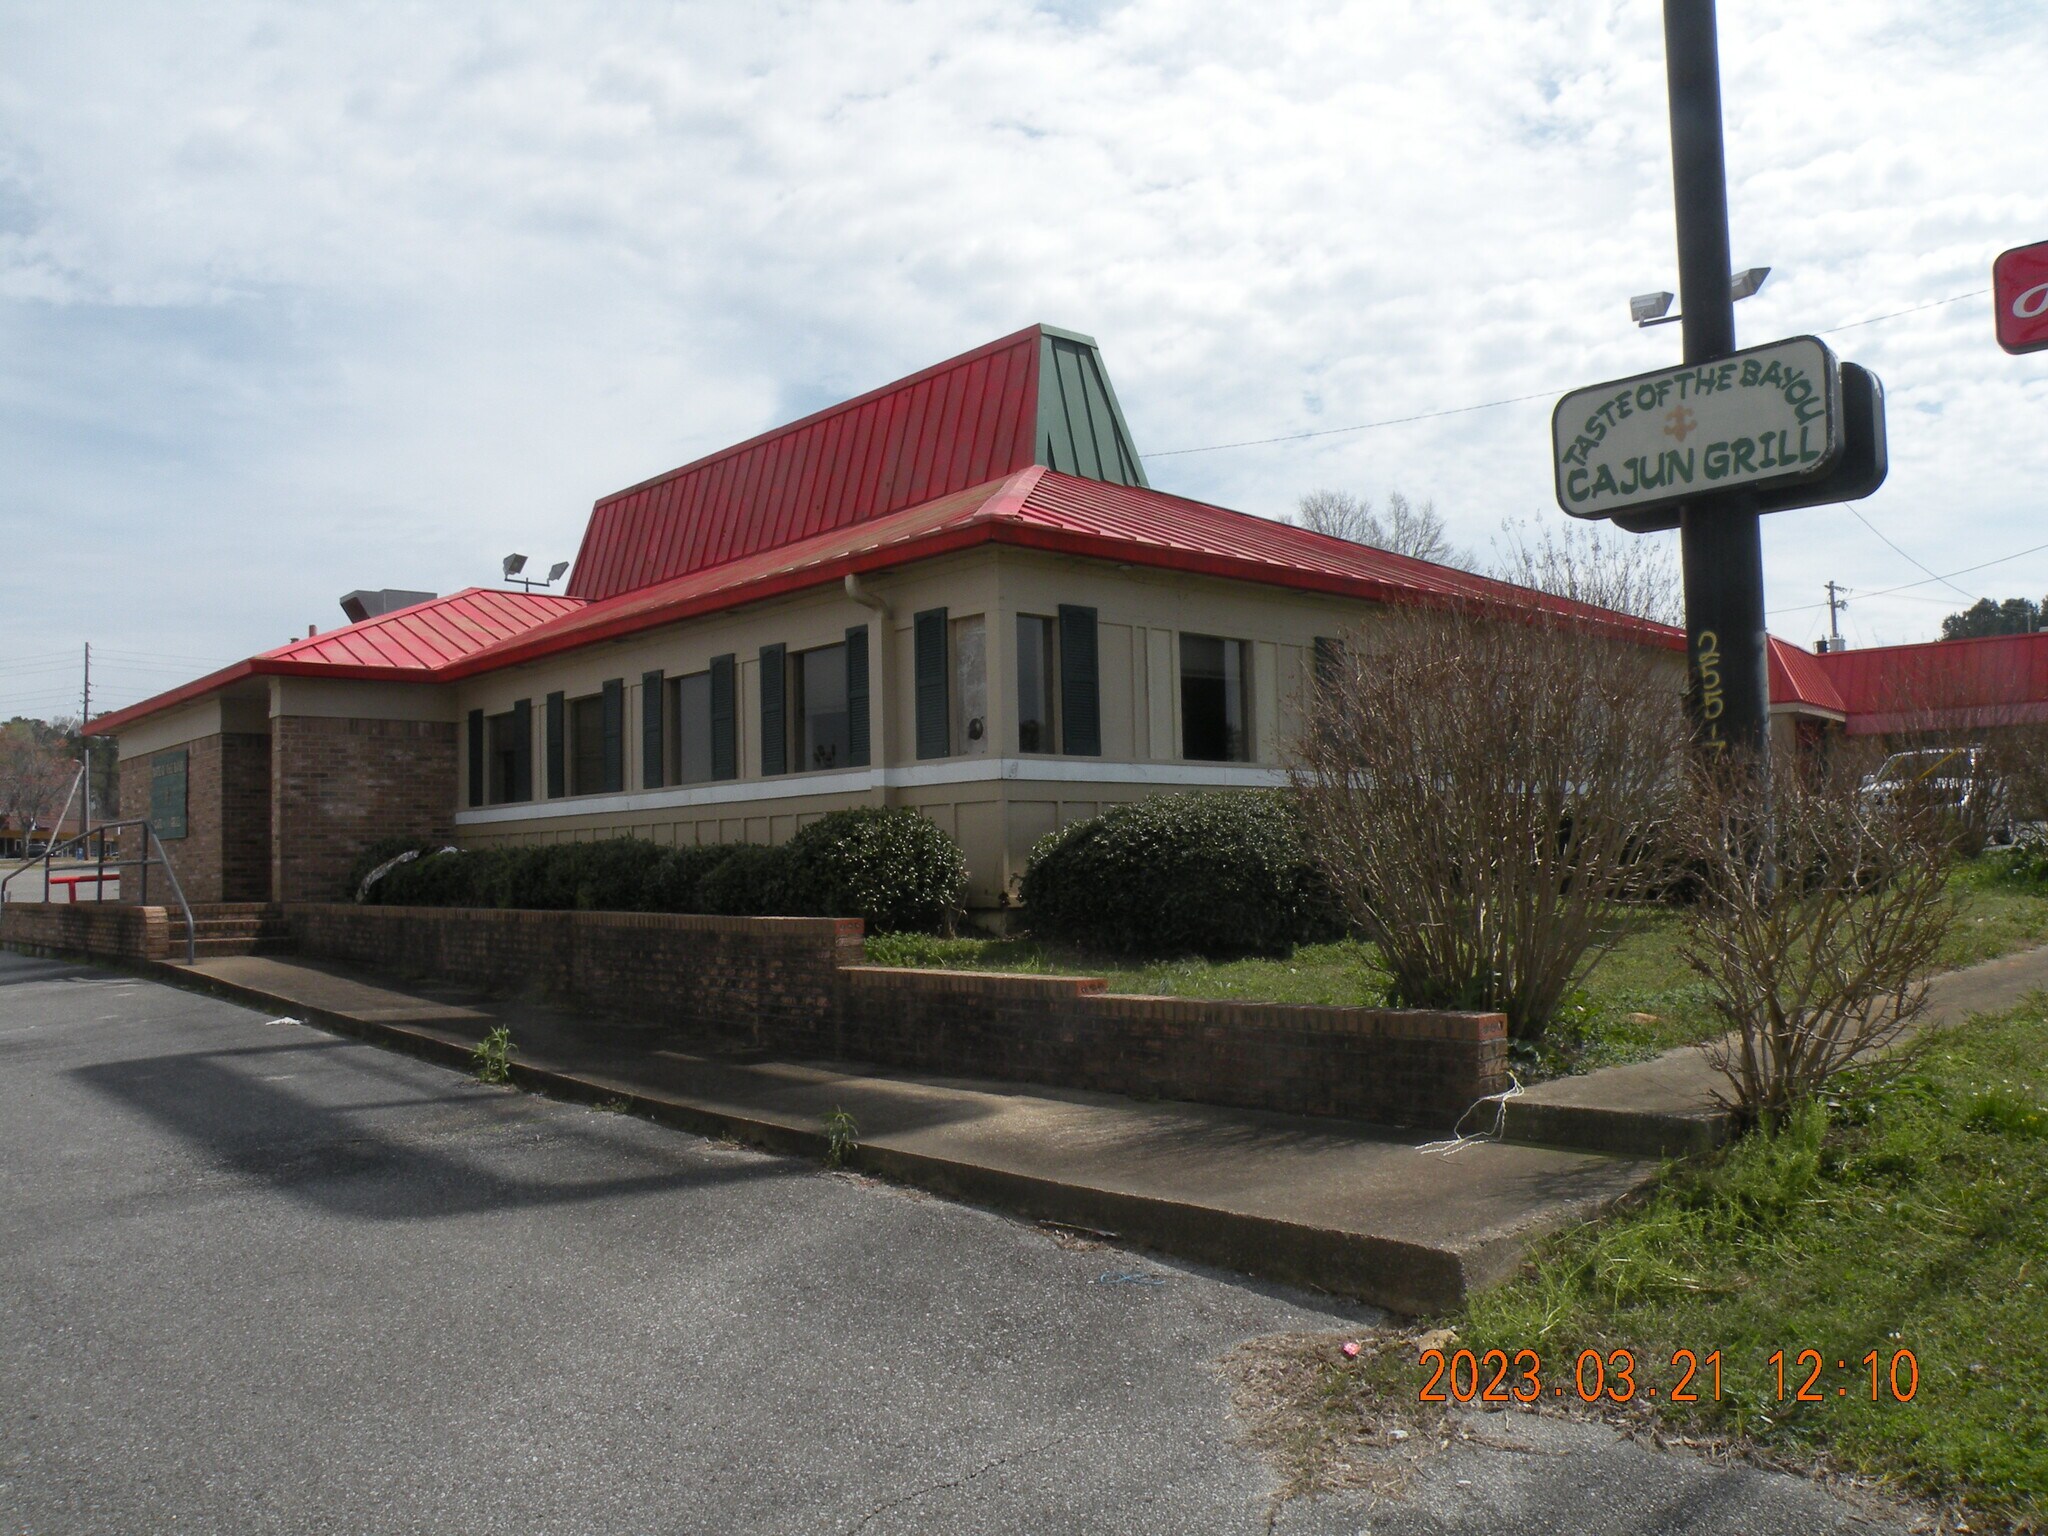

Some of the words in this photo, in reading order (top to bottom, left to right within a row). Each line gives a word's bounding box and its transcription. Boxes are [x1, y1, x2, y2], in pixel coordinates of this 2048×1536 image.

[1562, 390, 1633, 467] TASTE
[1636, 379, 1674, 411] OF
[1674, 363, 1738, 400] THE
[1739, 359, 1825, 426] BAYOU
[1567, 447, 1695, 502] CAJUN
[1703, 426, 1821, 480] GRILL
